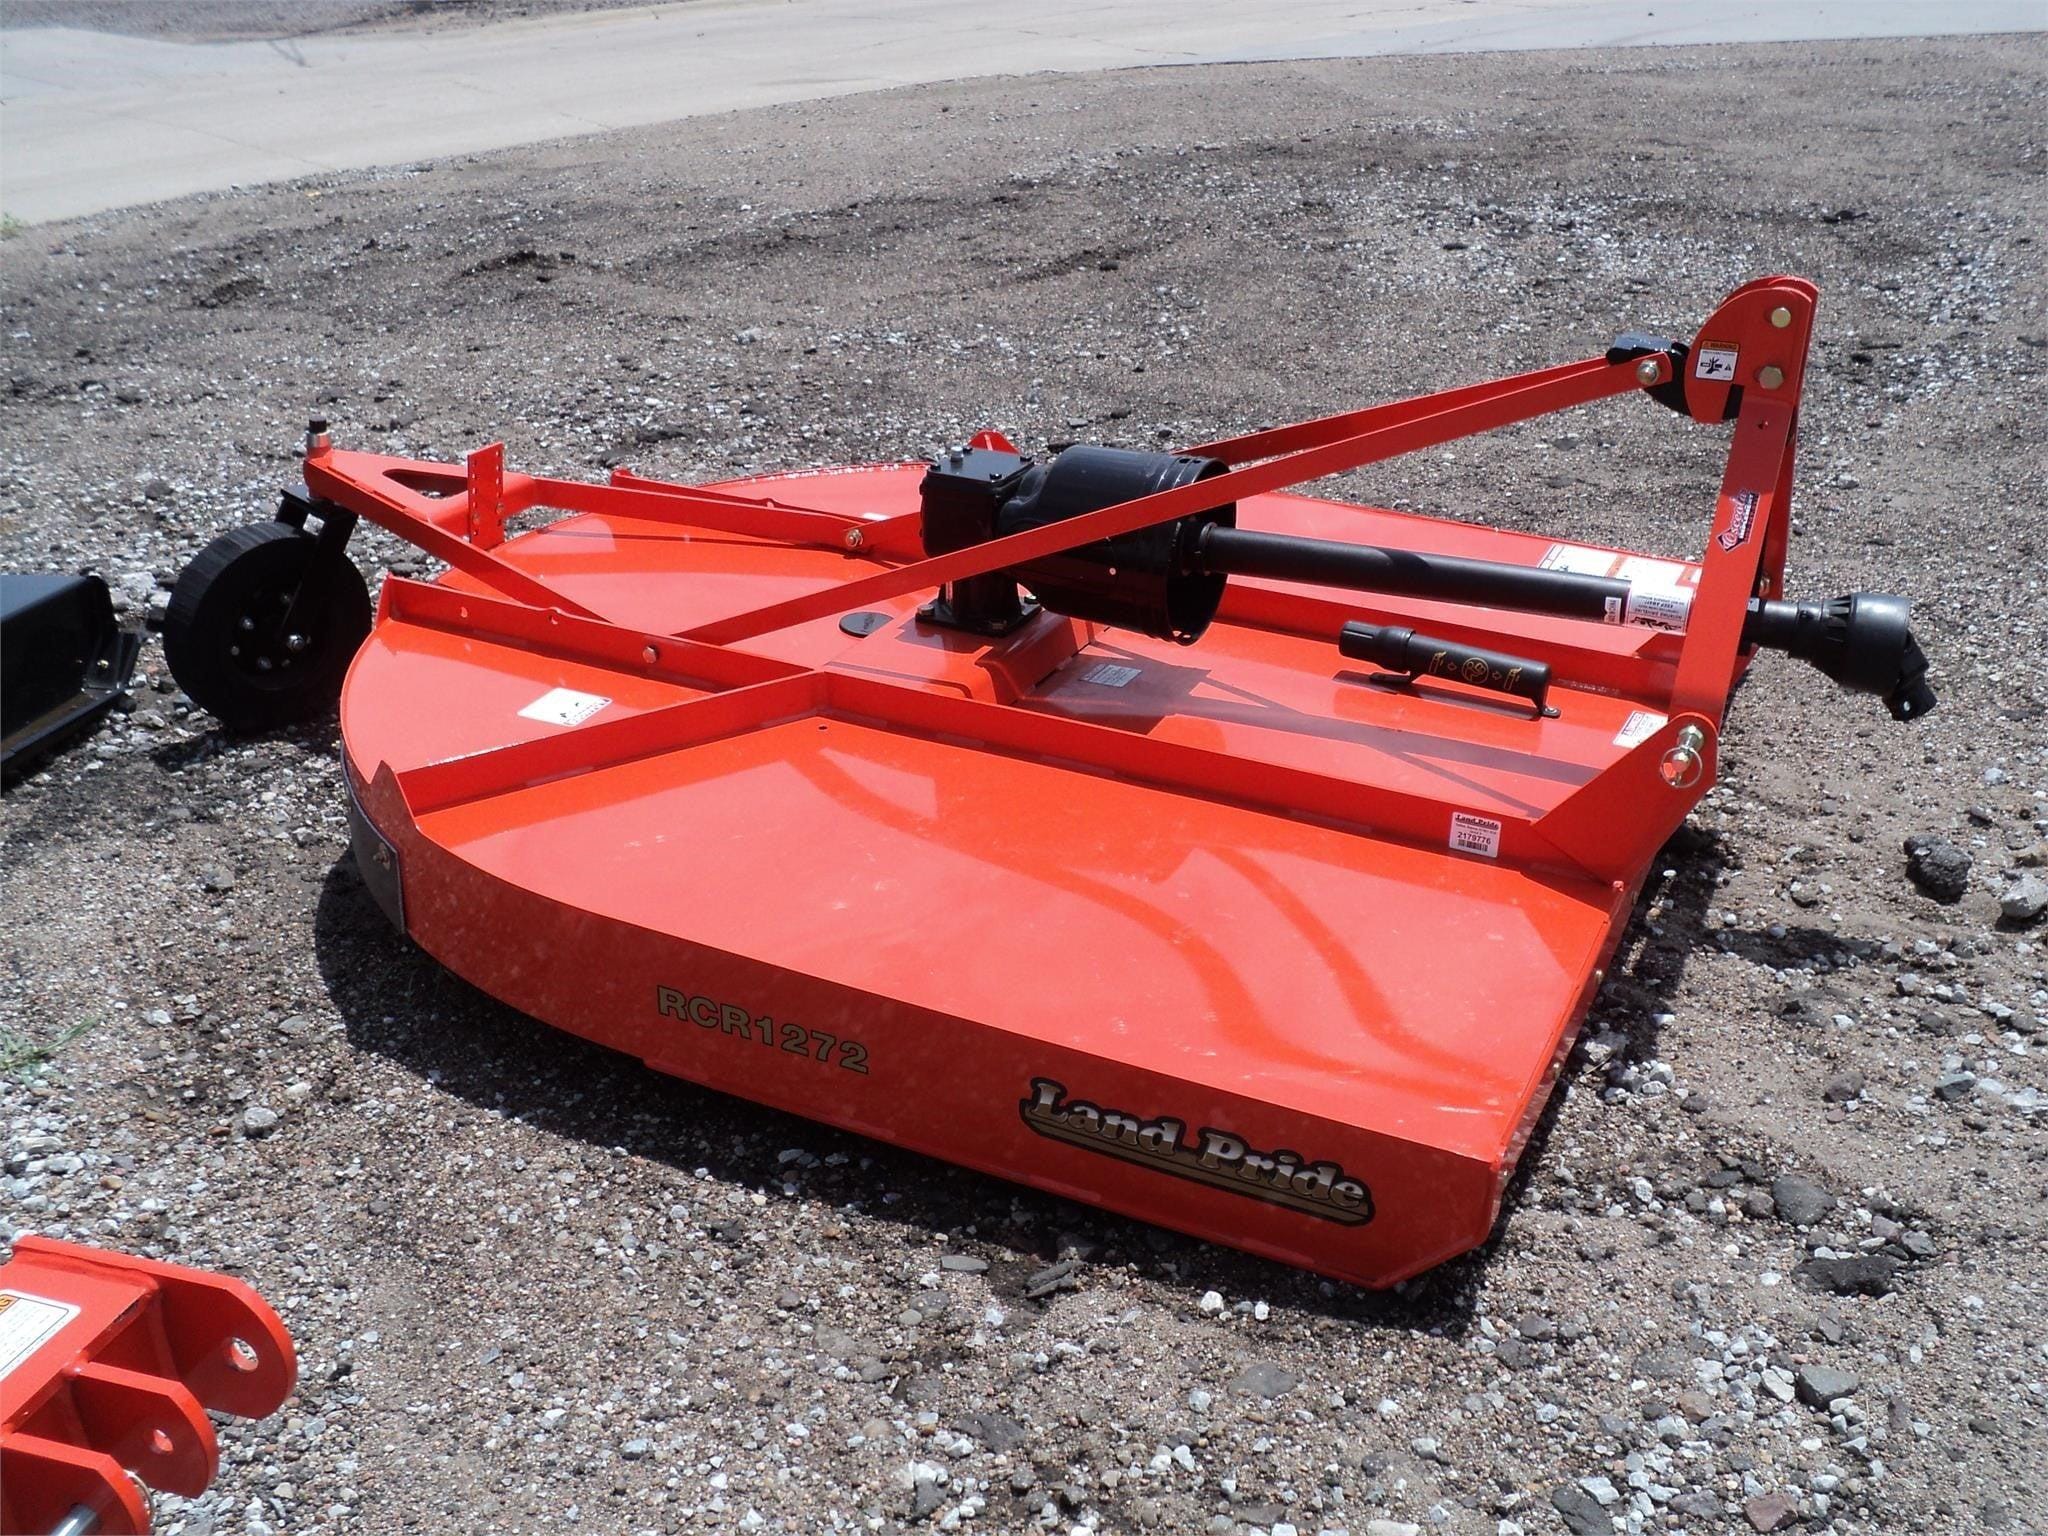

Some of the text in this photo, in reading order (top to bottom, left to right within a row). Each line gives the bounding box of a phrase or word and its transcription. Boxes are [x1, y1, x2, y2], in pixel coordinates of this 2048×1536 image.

[656, 984, 869, 1075] RCR1272
[1028, 1079, 1367, 1208] Land Pride
